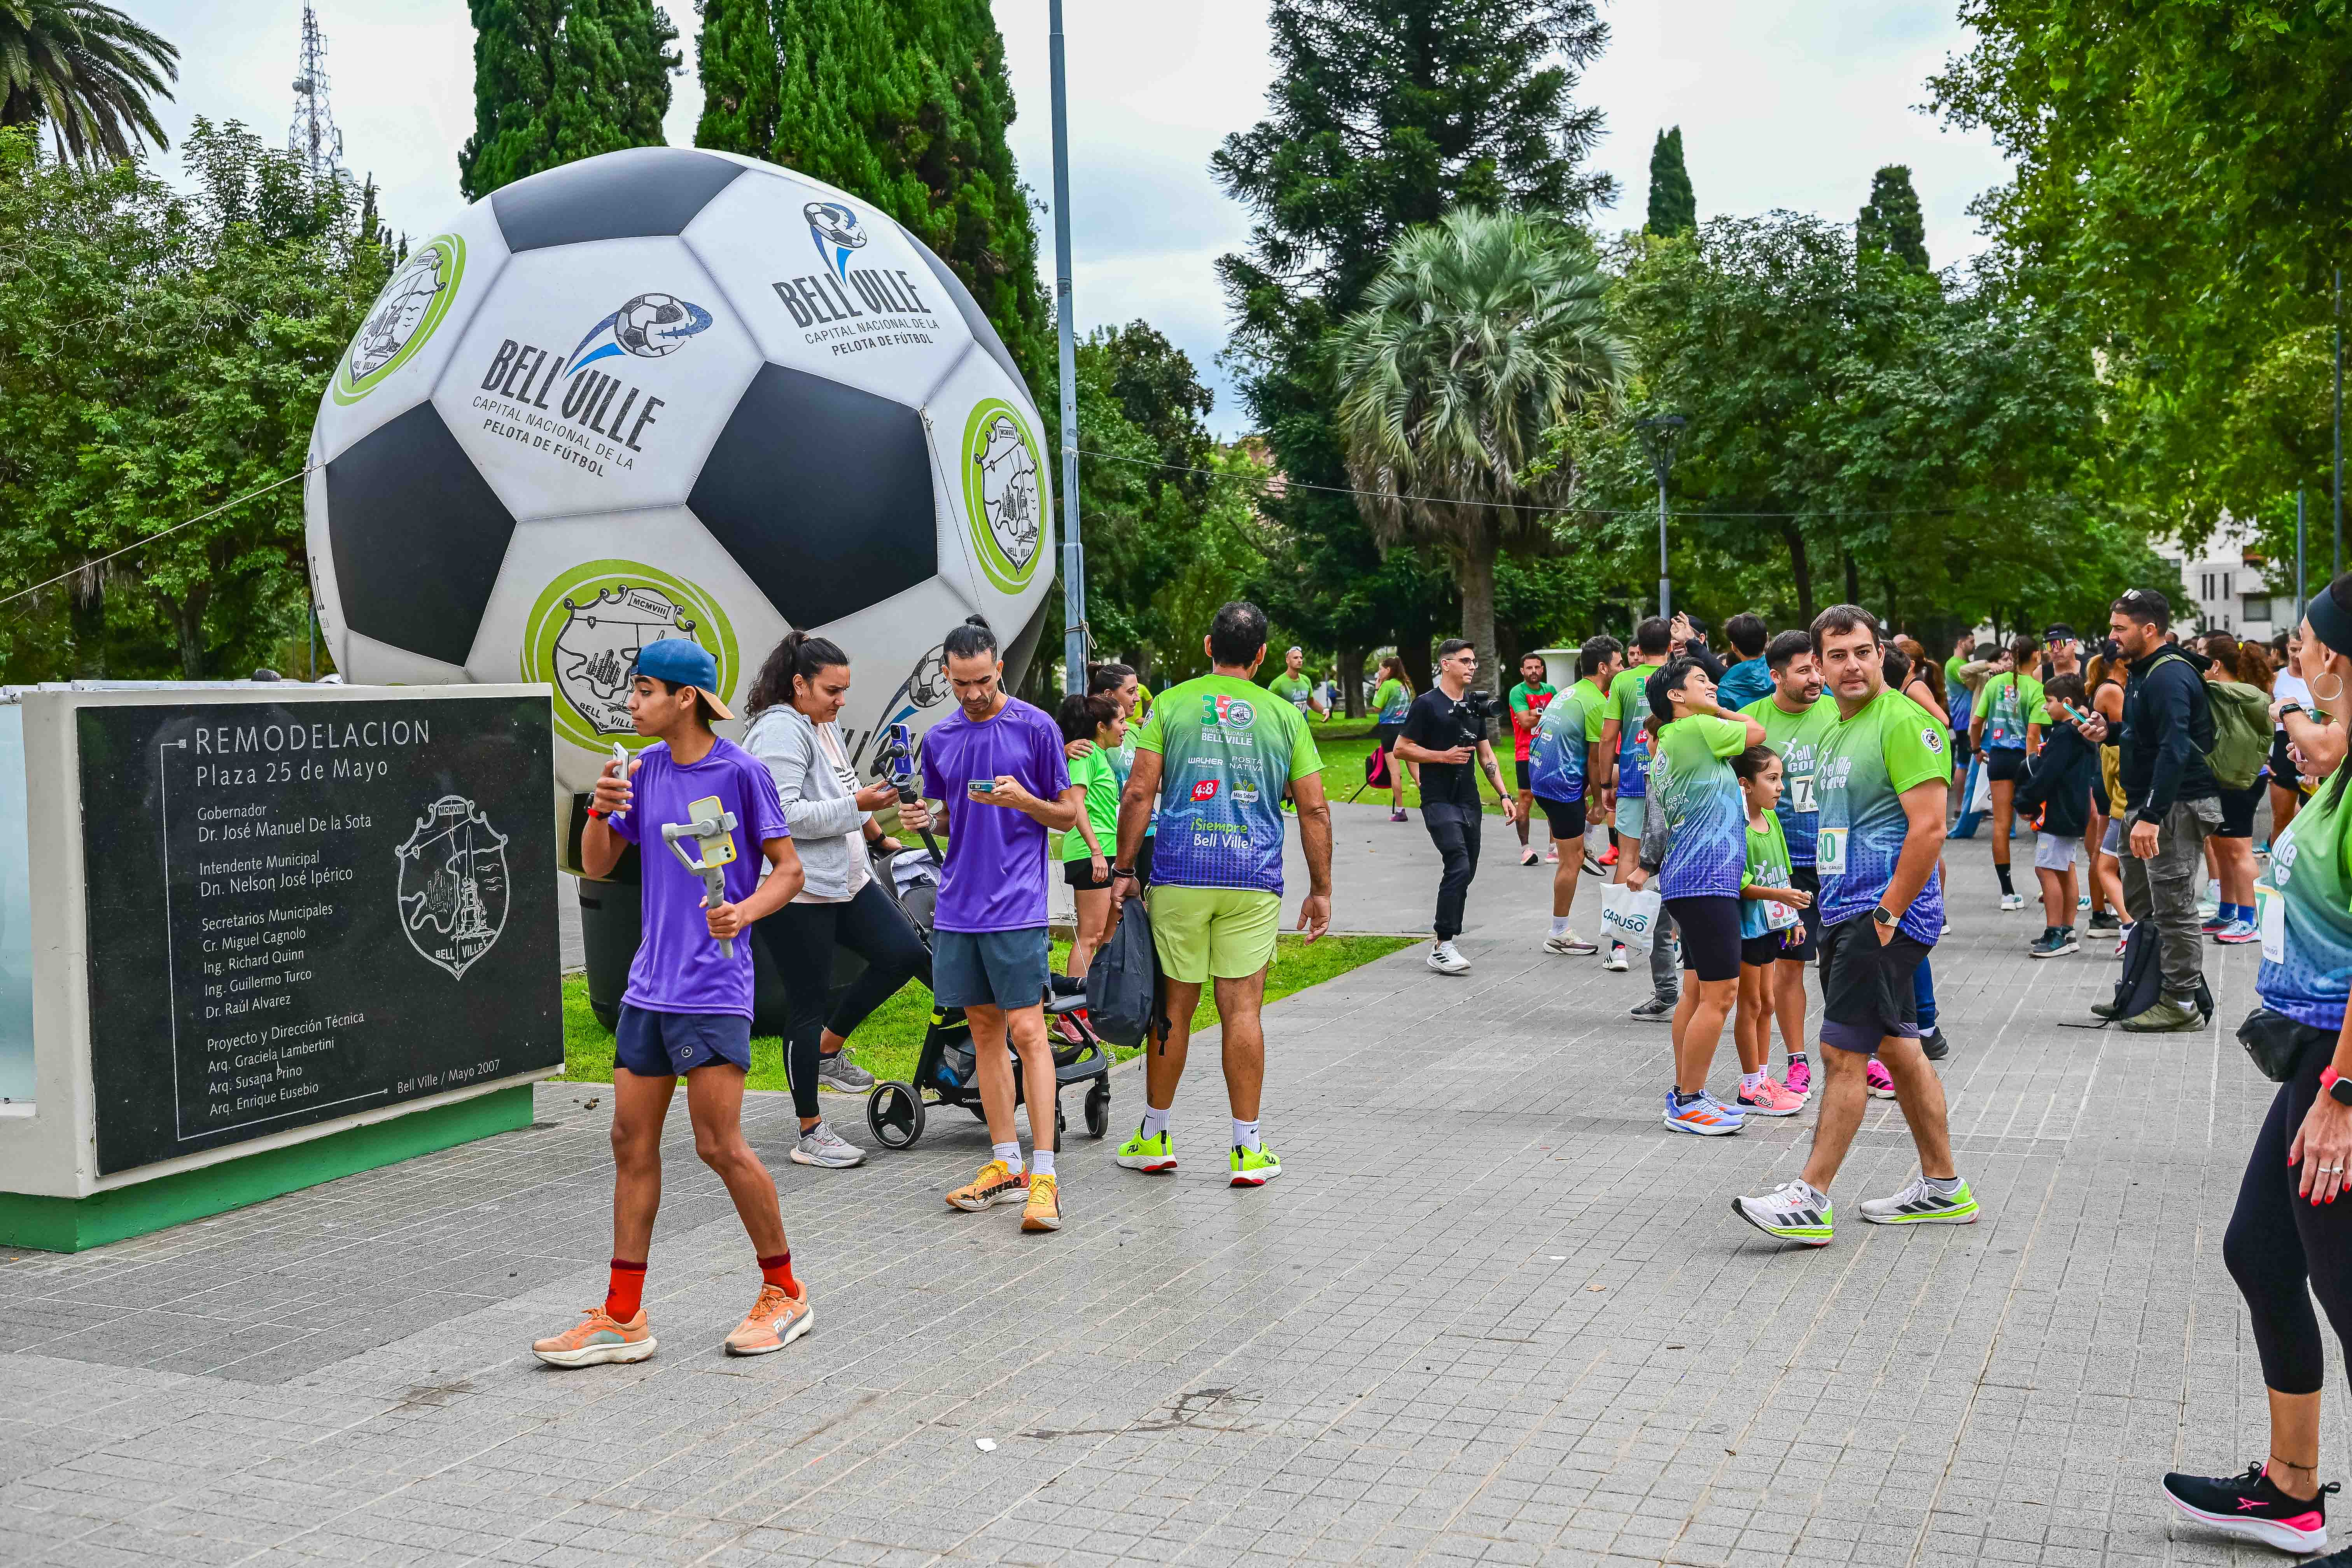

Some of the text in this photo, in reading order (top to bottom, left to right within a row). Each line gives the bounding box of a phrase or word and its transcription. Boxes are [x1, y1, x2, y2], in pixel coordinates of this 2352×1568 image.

[772, 270, 932, 328] BELL VILLE
[805, 318, 940, 344] CAPITAL NACIONAL DE LA
[831, 331, 933, 356] PELOTA DE FÚTBOL
[362, 362, 377, 370] VILLE
[480, 339, 665, 453] BELL VILLE
[473, 396, 634, 470] CAPITAL NACIONAL DE LA
[483, 418, 604, 478] PELOTA DE FÚTBOL
[1007, 547, 1030, 558] BELL VILLE
[633, 598, 667, 616] MCMVIII
[580, 702, 601, 719] BELL
[196, 719, 429, 754] REMODELACION
[1202, 727, 1244, 737] MUNICIPALIDAD
[1202, 732, 1252, 746] BELL VILLE
[197, 758, 387, 786] Plaza 25 de Mayo
[1229, 763, 1263, 772] NATIVA
[1232, 756, 1262, 765] POSTA
[1666, 793, 1686, 805] POSTA
[198, 803, 266, 821] Gobernador
[199, 814, 372, 842] Dr. José Manuel De la Sota
[1194, 833, 1254, 851] Bell Ville!
[200, 850, 319, 875] Intendente Municipal
[200, 867, 353, 897] Dn. Nelson José Ipérico
[202, 903, 333, 931] Secretarios Municipales
[1603, 908, 1644, 932] CARUSO
[203, 926, 305, 952] Cr. Miguel Cagnolo
[1619, 927, 1643, 937] SEGUROS
[204, 949, 304, 976] Ing. Richard Quinn
[436, 944, 483, 960] BELL VILLE
[205, 970, 312, 998] Ing. Guillermo Turco
[206, 996, 291, 1018] Dr. Raúl Alvarez
[208, 1012, 364, 1052] Proyecto y Dirección Técnica
[208, 1037, 334, 1074] Arq. Graciela Lambertini
[209, 1082, 232, 1096] Arq.
[236, 1072, 273, 1089] Susana
[398, 1078, 414, 1094] Bell
[417, 1074, 438, 1088] Ville
[449, 1068, 474, 1082] Mayo
[477, 1059, 500, 1074] 2007
[210, 1083, 318, 1116] Arq. Enrique Eusebio
[1754, 1095, 1774, 1108] FILA
[1127, 1143, 1139, 1154] FILA
[977, 1176, 1022, 1203] NITRO
[772, 1309, 794, 1335] FILA
